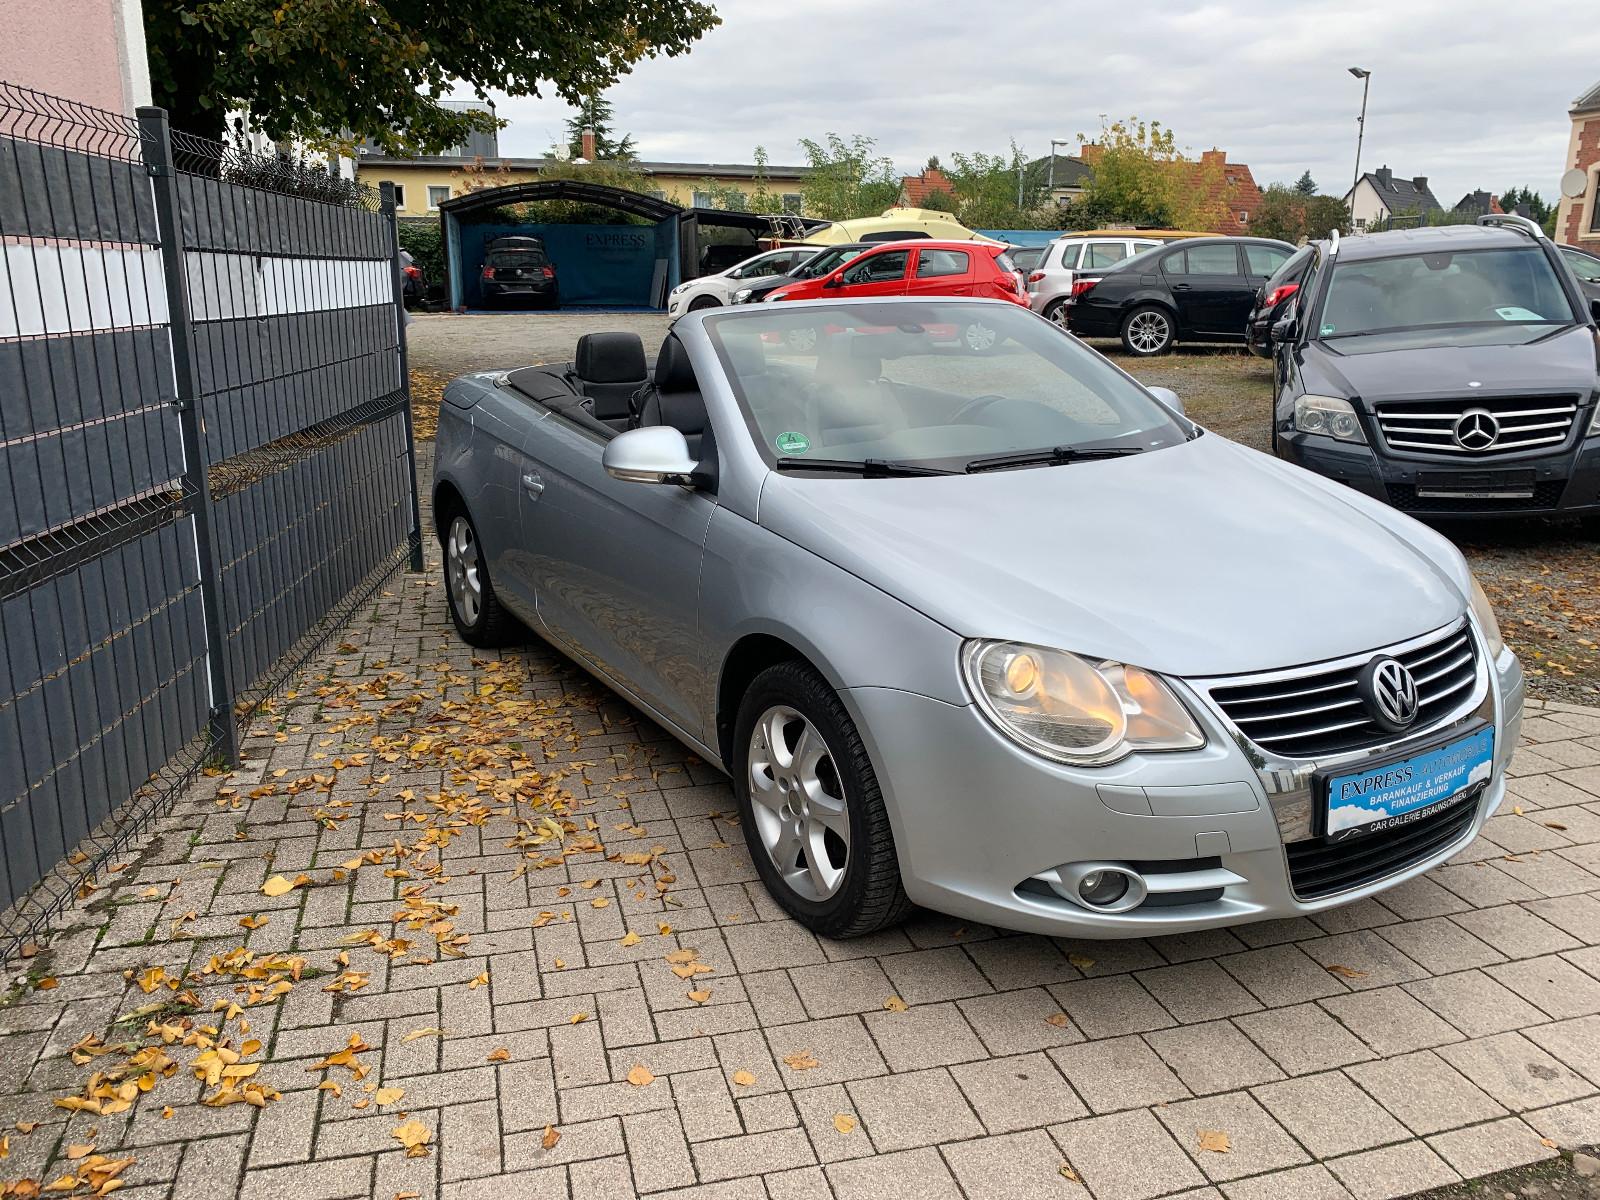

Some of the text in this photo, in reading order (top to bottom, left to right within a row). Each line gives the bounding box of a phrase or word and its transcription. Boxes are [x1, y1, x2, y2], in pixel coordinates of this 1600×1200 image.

[585, 233, 646, 248] EXPRESS
[1341, 765, 1414, 801] EXPRESS
[1369, 766, 1467, 806] BARANKAUF & VERKAUF
[1391, 782, 1449, 810] FINANZIERUNG
[1370, 790, 1468, 832] CAR GALERIE BRAUNSCHWEIG
